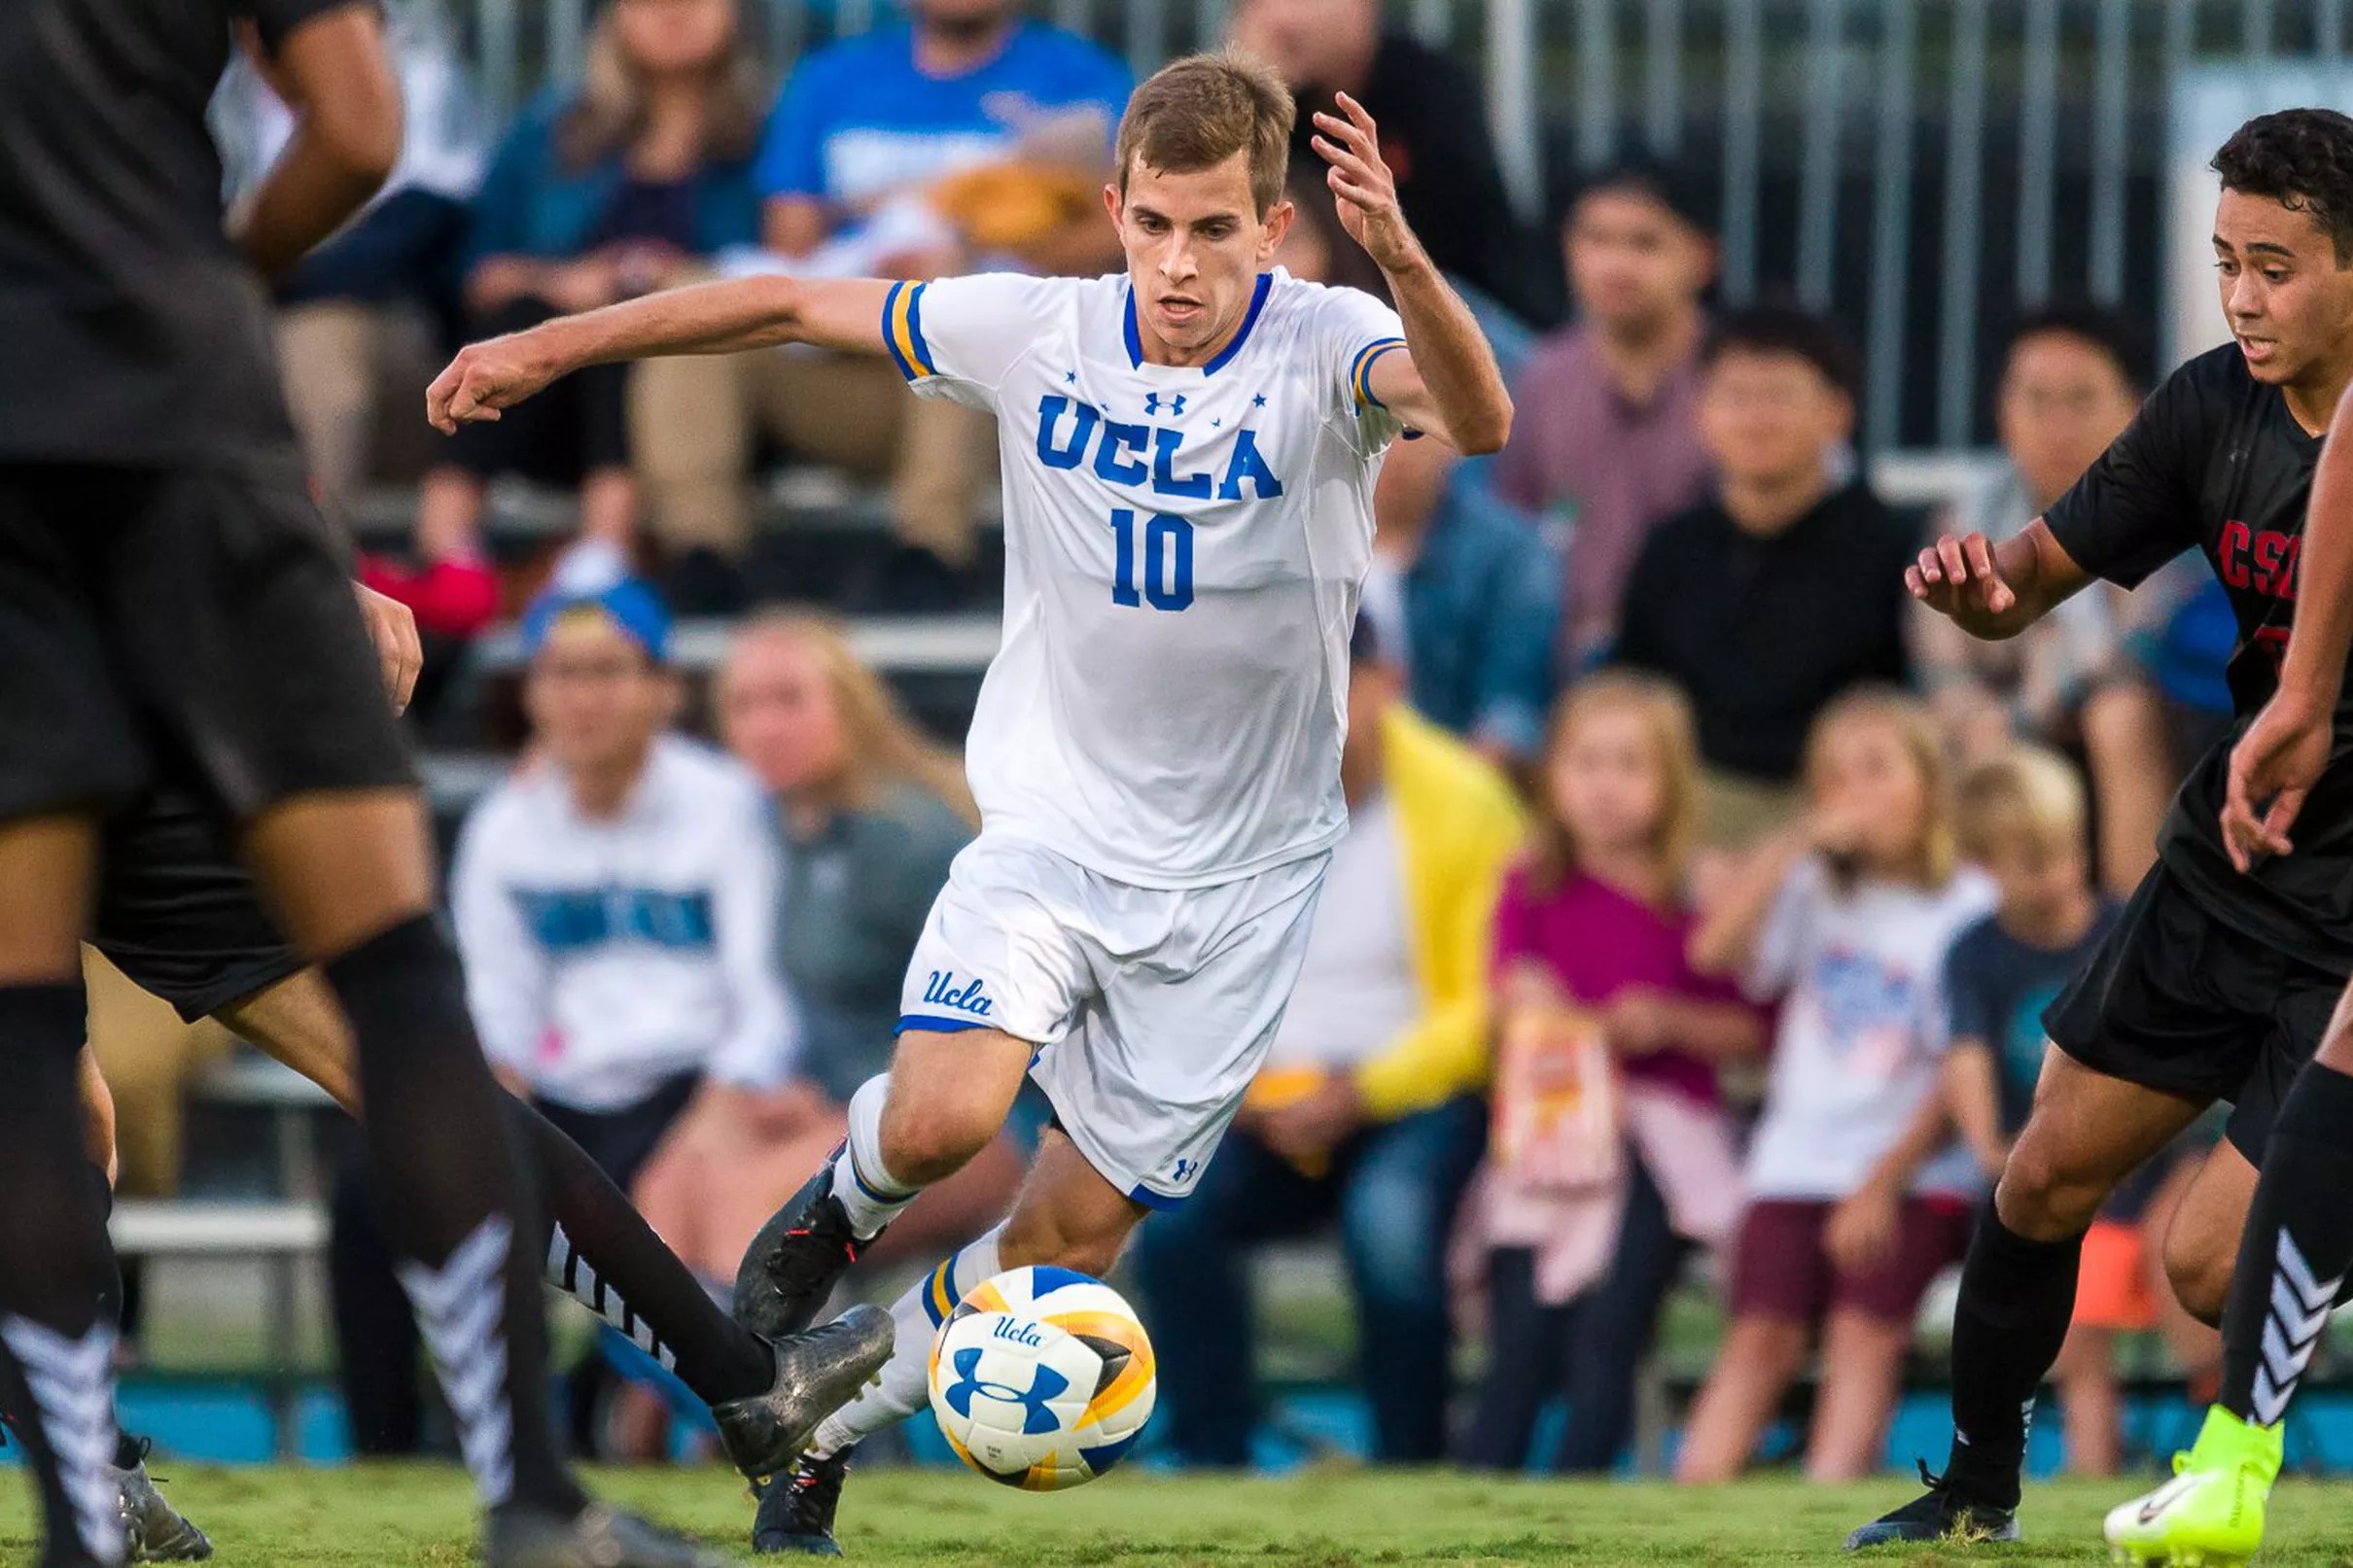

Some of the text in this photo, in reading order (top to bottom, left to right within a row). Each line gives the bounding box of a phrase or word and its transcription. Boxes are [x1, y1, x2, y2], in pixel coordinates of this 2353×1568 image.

[1036, 395, 1283, 500] UCLA
[1110, 507, 1194, 610] 10
[923, 970, 993, 1016] Ucla
[994, 1316, 1041, 1347] Ucla
